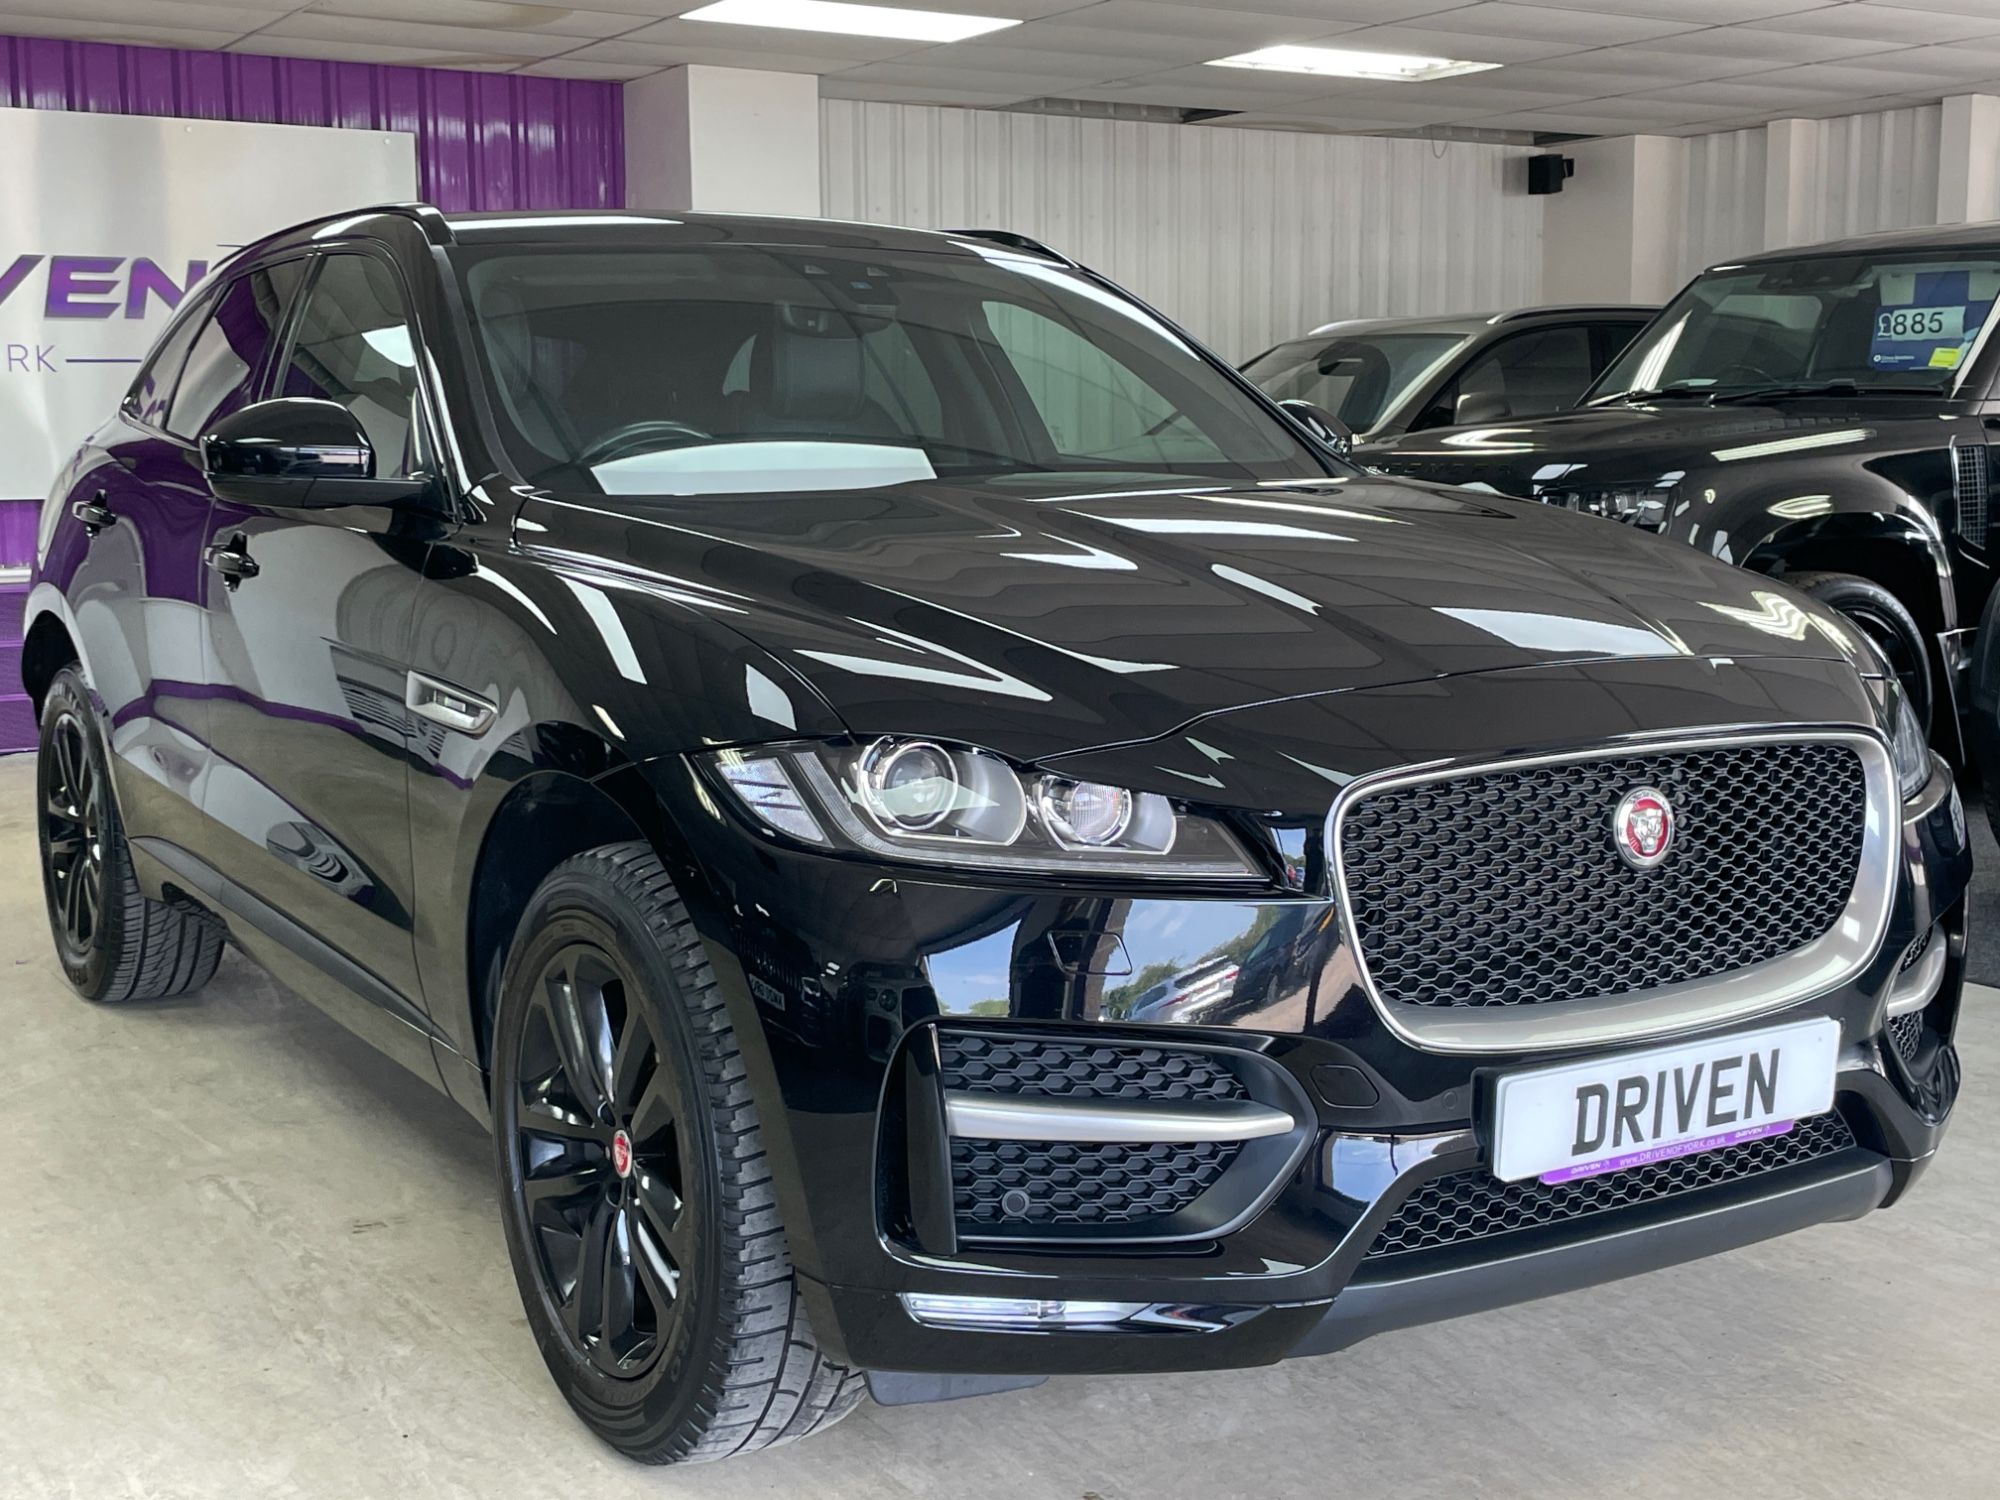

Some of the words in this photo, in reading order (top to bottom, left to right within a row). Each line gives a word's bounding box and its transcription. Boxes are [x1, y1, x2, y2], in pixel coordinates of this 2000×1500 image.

[1878, 311, 1943, 337] £885
[1571, 1048, 1780, 1156] DRIVEN
[1570, 1163, 1601, 1175] DRIVEN
[1735, 1127, 1763, 1138] DRIVEN
